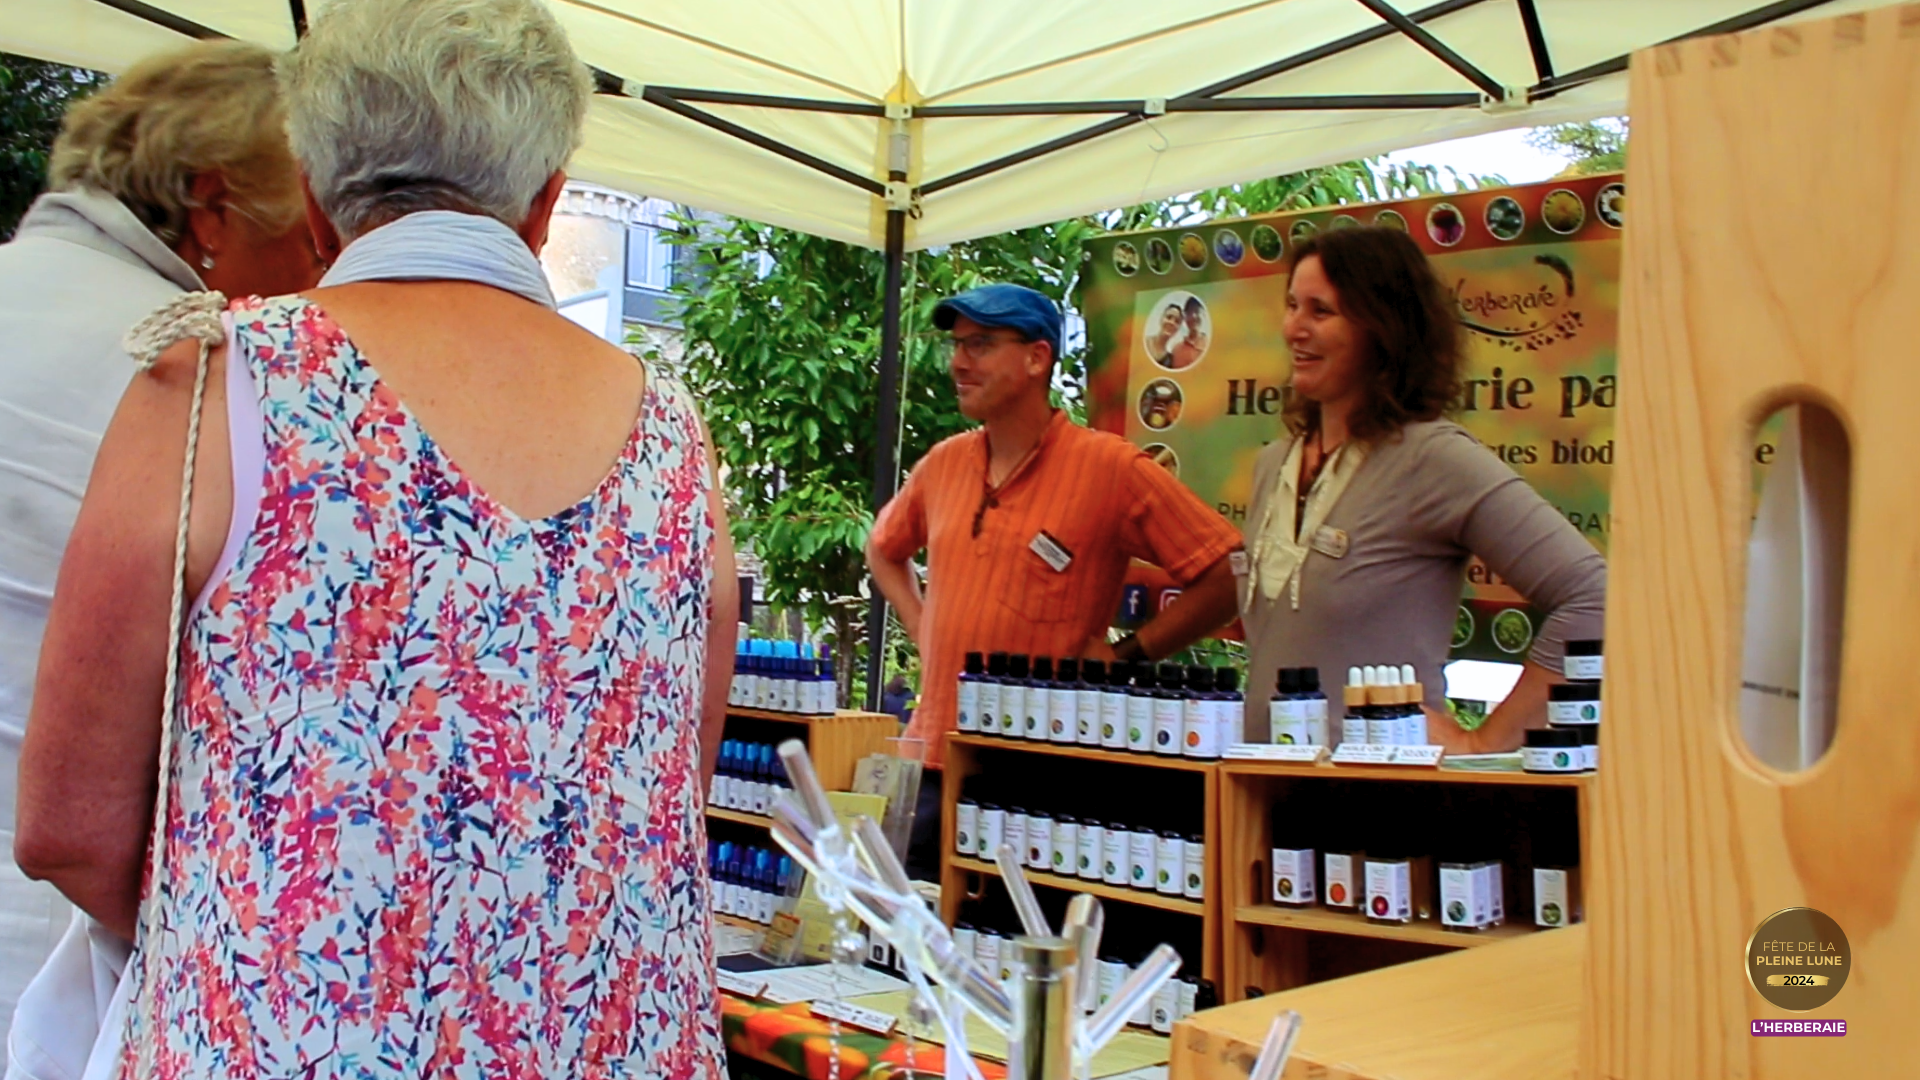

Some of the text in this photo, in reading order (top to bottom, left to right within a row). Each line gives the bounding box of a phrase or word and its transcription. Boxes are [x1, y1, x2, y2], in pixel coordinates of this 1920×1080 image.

[1463, 367, 1535, 411] rie
[1559, 374, 1617, 418] pa
[1487, 443, 1538, 464] tes
[1551, 438, 1615, 464] biod
[1218, 502, 1247, 521] PH
